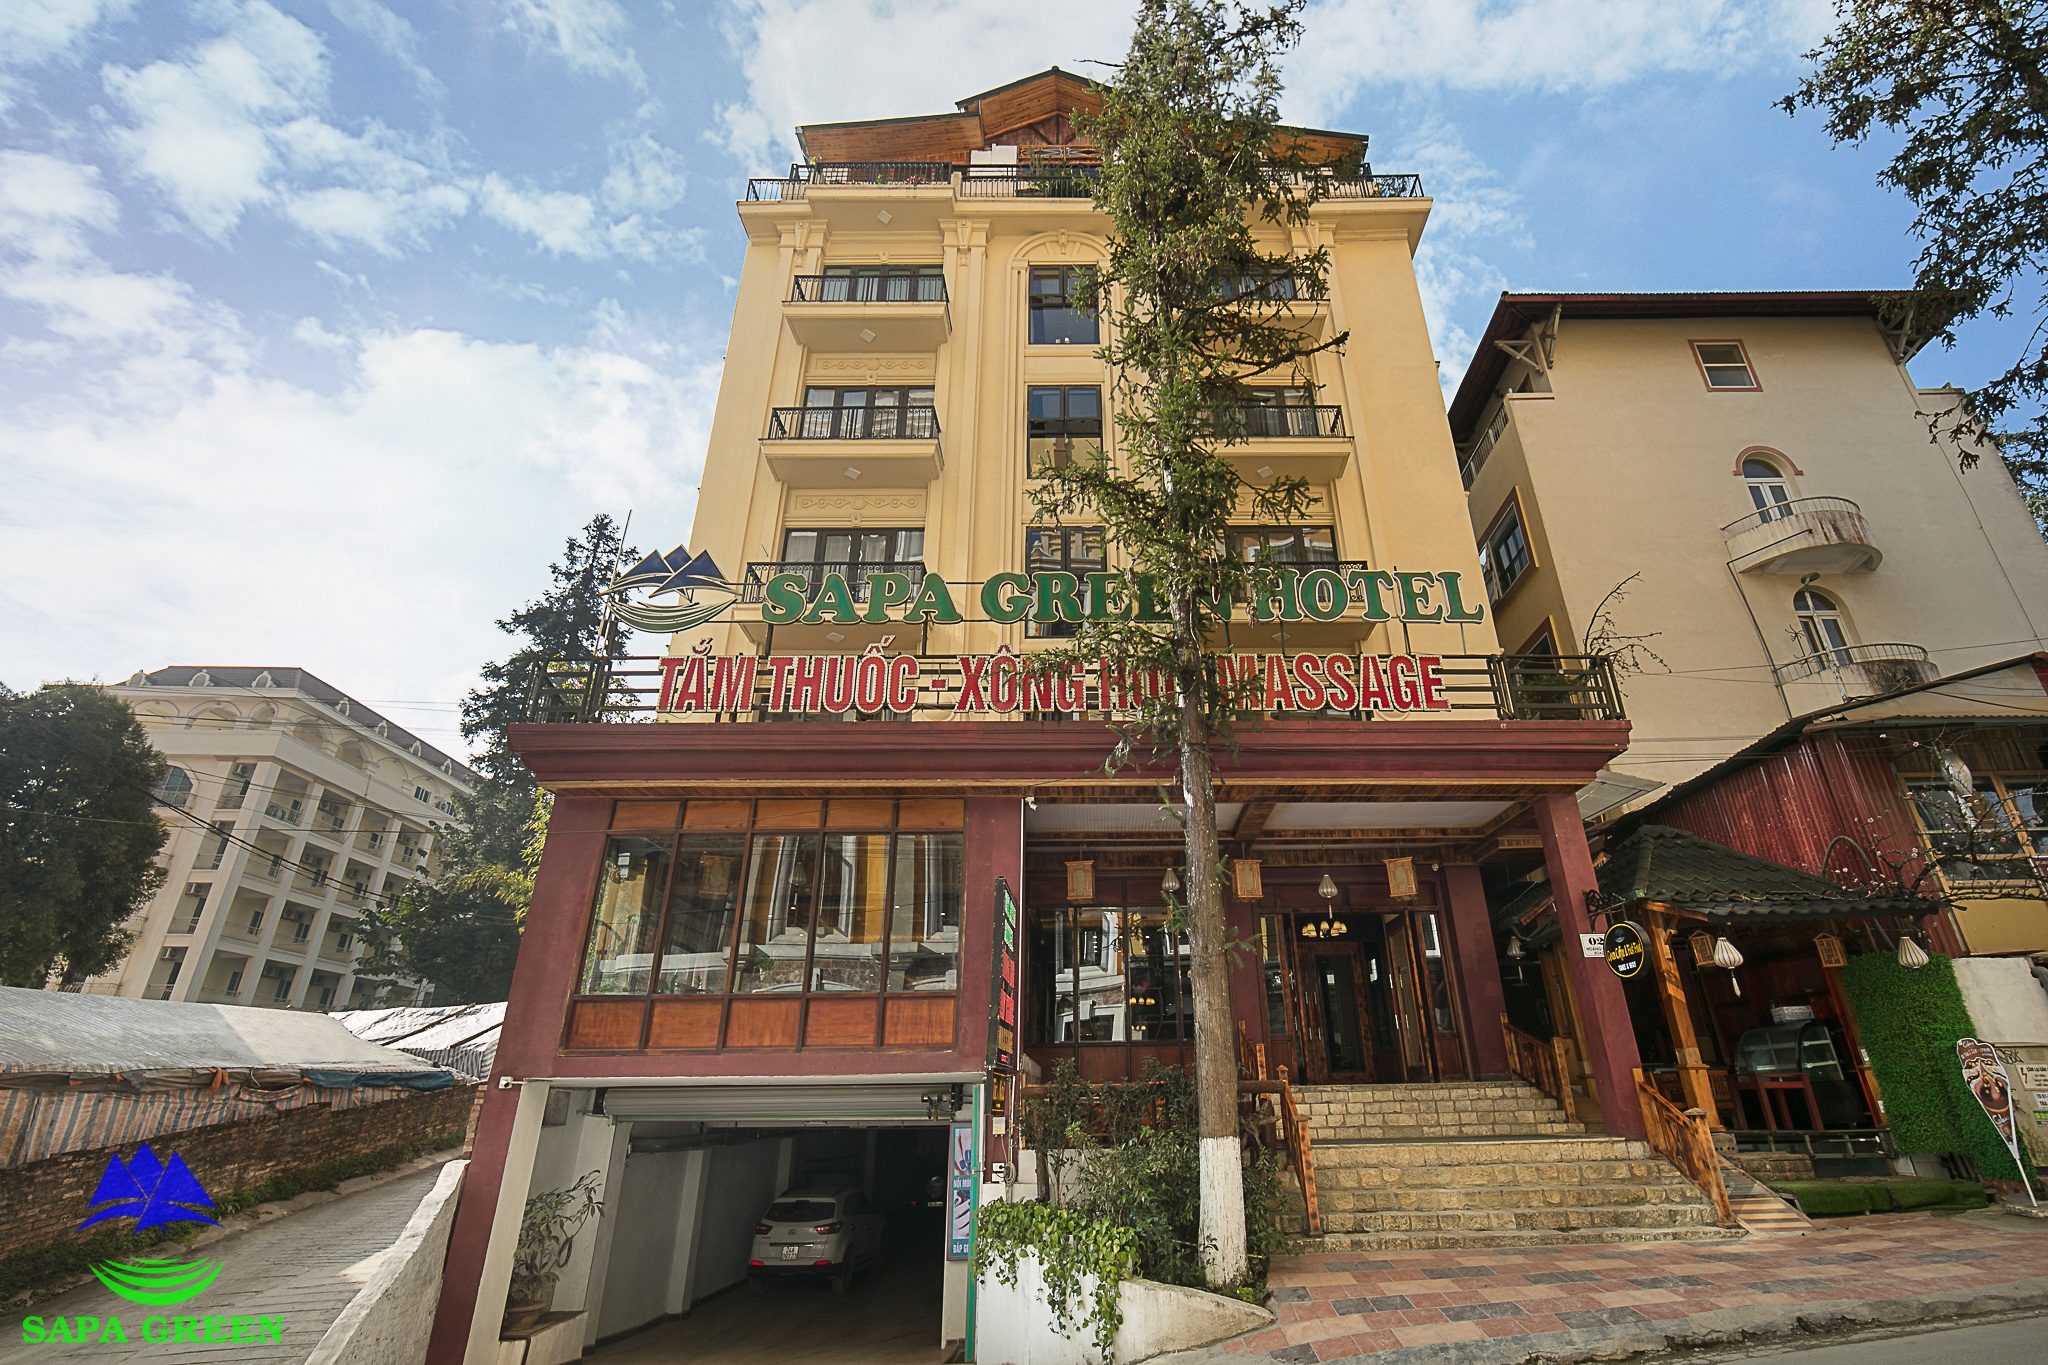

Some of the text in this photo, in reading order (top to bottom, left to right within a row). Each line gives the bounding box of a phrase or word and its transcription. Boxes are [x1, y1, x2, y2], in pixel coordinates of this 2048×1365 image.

[762, 572, 963, 625] SAPA
[1254, 568, 1484, 624] HOTEL
[656, 637, 759, 713] TẮM
[767, 634, 920, 713] THUỐC
[954, 643, 1086, 713] XÔNG
[1216, 652, 1451, 712] MASSAGE
